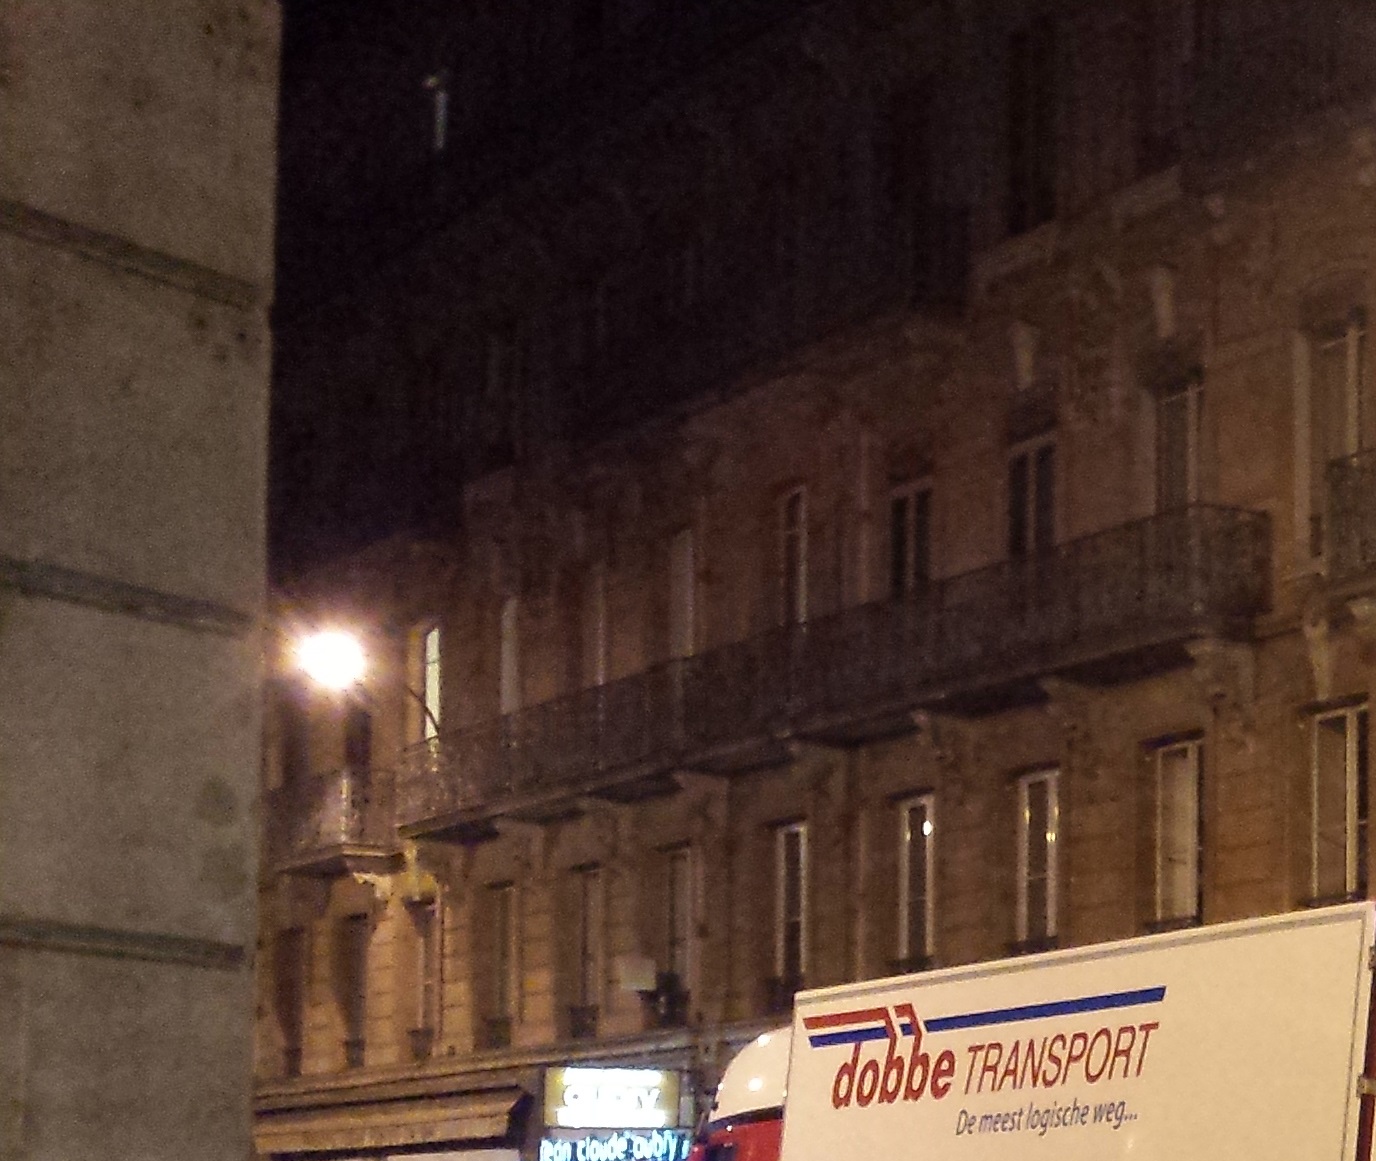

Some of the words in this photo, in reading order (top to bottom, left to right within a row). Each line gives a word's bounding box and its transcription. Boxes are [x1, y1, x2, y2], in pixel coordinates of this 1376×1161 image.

[832, 1024, 956, 1110] dobbe
[964, 1022, 1160, 1095] TRANSPORT
[956, 1109, 977, 1136] De
[978, 1107, 1024, 1133] meest
[1026, 1097, 1089, 1136] logische
[1093, 1100, 1138, 1131] weg...
